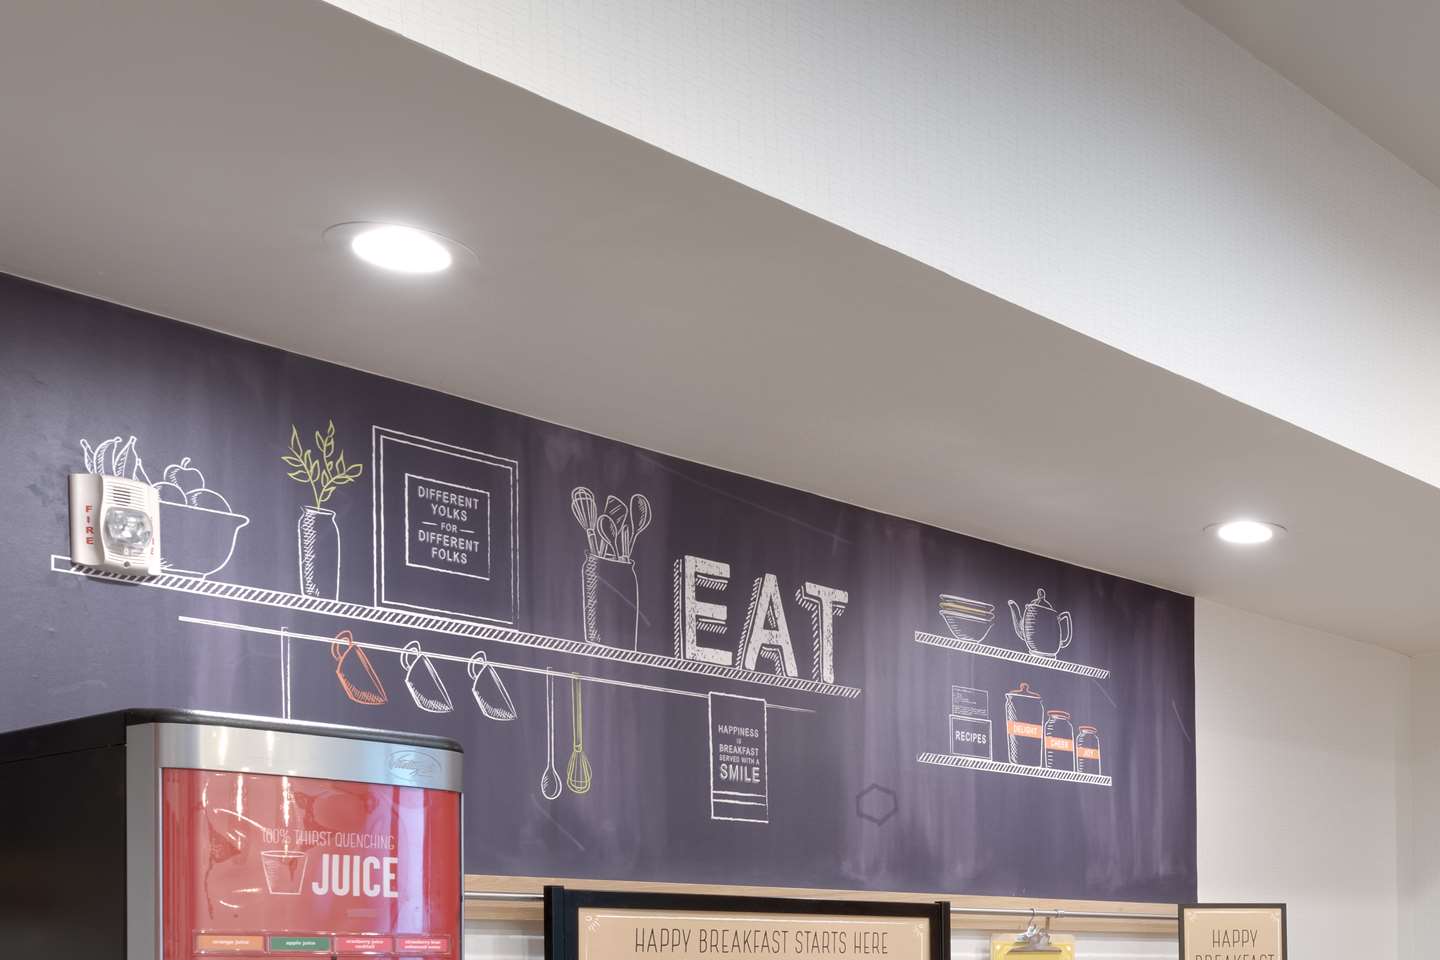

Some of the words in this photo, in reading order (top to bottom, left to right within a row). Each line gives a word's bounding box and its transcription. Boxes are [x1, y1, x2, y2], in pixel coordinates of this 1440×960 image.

[417, 486, 480, 510] DIFFERENT
[431, 503, 468, 522] YOLKS
[84, 505, 94, 545] FIRE
[440, 521, 458, 534] FOR
[418, 529, 480, 553] DIFFERENT
[431, 547, 468, 565] FOLKS
[674, 554, 849, 684] EAT
[718, 724, 760, 738] HAPPINESS
[955, 730, 987, 745] RECIPES
[719, 743, 759, 757] BREAKFAST
[720, 763, 761, 783] SMILE
[262, 829, 291, 845] 100%
[295, 829, 333, 848] THIRST
[335, 832, 396, 850] QUENCHING
[312, 853, 399, 898] JUICE
[634, 927, 692, 953] HAPPY
[699, 928, 790, 954] BREAKFAST
[794, 930, 848, 954] STARTS
[853, 931, 889, 954] HERE
[1212, 929, 1258, 948] HAPPY
